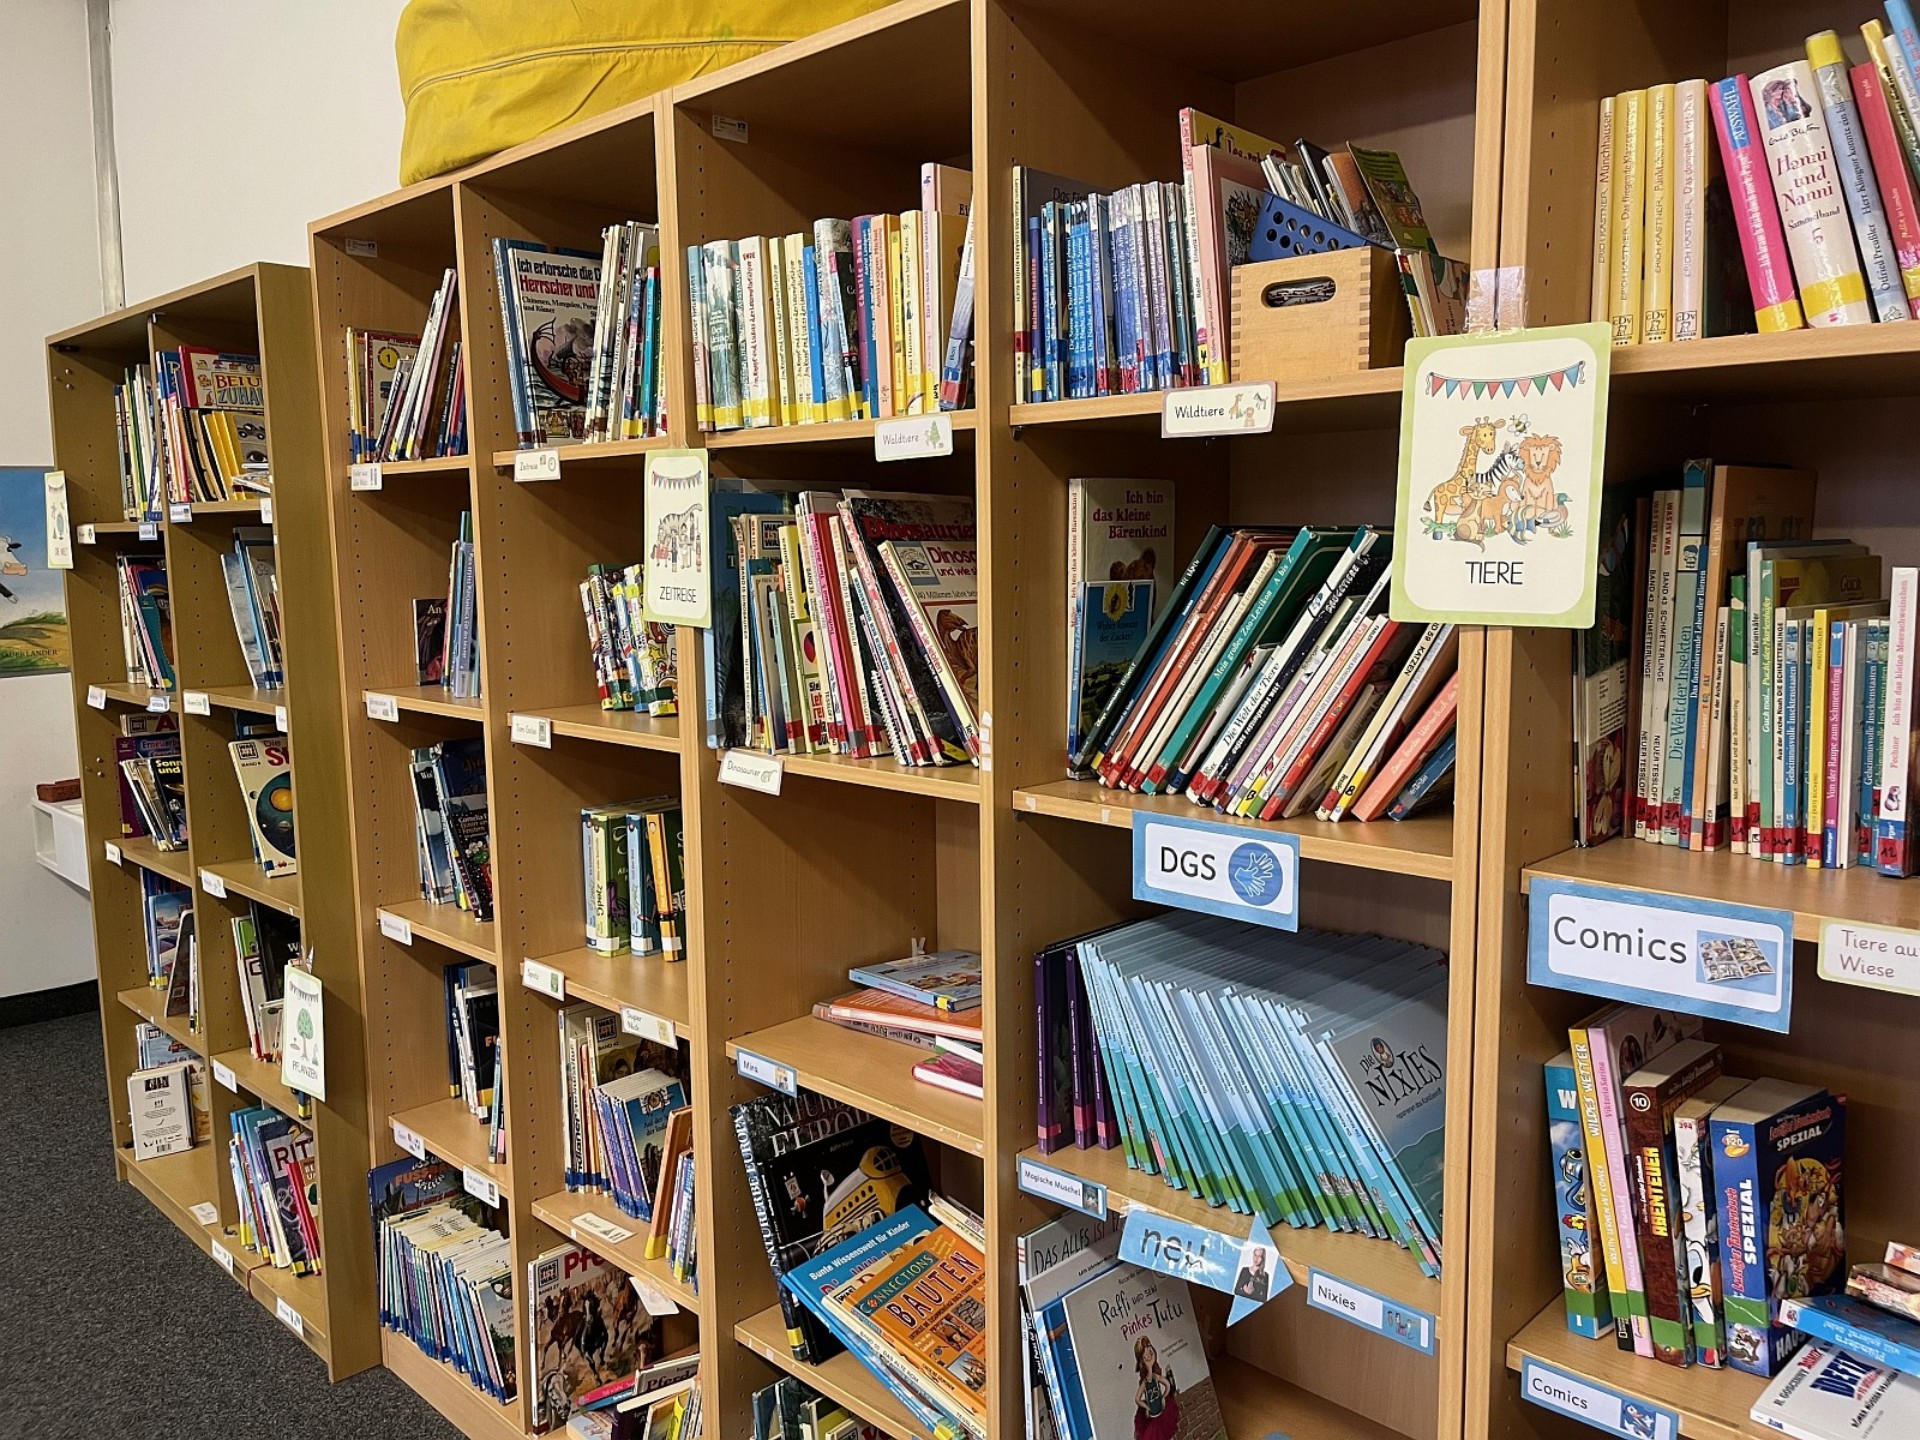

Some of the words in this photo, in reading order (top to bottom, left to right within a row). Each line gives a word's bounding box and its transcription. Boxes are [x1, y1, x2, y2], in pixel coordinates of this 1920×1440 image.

[1724, 85, 1746, 140] AUSWAHL
[1600, 111, 1612, 183] Münchhausen
[1776, 146, 1828, 177] Hanni
[1683, 177, 1693, 195] Das
[1794, 165, 1828, 188] und
[1781, 181, 1833, 212] Nanni
[1861, 194, 1872, 215] Herr
[1812, 227, 1823, 244] 5
[1867, 224, 1882, 259] Preußler
[517, 257, 532, 273] Ich
[534, 260, 578, 279] erforsche
[580, 264, 594, 279] die
[520, 275, 573, 297] Herrscher
[576, 283, 595, 299] und
[385, 353, 392, 364] 1
[216, 375, 246, 389] BEI
[1174, 404, 1225, 421] Wildtiere
[882, 432, 919, 446] Waldtiere
[1126, 491, 1143, 504] Ich
[1146, 491, 1164, 504] bin
[1093, 508, 1113, 522] das
[1116, 508, 1150, 522] kleine
[1665, 502, 1674, 521] WAS
[1108, 525, 1167, 539] Bärenkind
[1664, 522, 1673, 536] IST
[1663, 537, 1672, 556] WAS
[937, 568, 955, 576] und
[957, 568, 970, 576] wie
[1465, 560, 1525, 585] TIERE
[1648, 569, 1657, 592] BAND
[1662, 571, 1670, 595] BAND
[1696, 569, 1706, 596] Bienen
[659, 586, 697, 603] ZEITREISE
[1695, 597, 1704, 607] der
[427, 604, 442, 614] An
[845, 599, 857, 646] DINOSAURIER
[881, 547, 908, 597] Dinosaurier
[905, 600, 917, 616] und
[914, 615, 924, 634] wie
[921, 634, 930, 647] sie
[928, 646, 943, 674] lebten
[1213, 660, 1230, 680] Mein
[1227, 638, 1244, 661] großes
[1241, 590, 1273, 637] Zoo-Lexikon
[1273, 577, 1281, 586] A
[1278, 564, 1289, 577] bis
[1286, 554, 1295, 564] Z
[1693, 608, 1703, 634] Leben
[1896, 580, 1908, 656] Meerschweinchen
[1643, 607, 1655, 679] SCHMETTERLINGE
[1657, 609, 1668, 682] SCHMETTERLINGE
[1672, 624, 1692, 680] Insekten
[1775, 622, 1784, 682] SCHMETTERLINGE
[1403, 646, 1427, 677] KATZEN
[1690, 636, 1702, 683] faszinierende
[1893, 653, 1903, 678] kleine
[1671, 682, 1687, 704] der
[1689, 685, 1698, 698] Das
[1787, 665, 1796, 724] Insektenstaaten
[1829, 668, 1842, 721] Schmetterling
[1866, 665, 1877, 723] Insektenstaaten
[1892, 680, 1901, 695] das
[1223, 728, 1237, 747] Die
[1235, 709, 1250, 731] Welt
[1250, 688, 1262, 707] der
[1260, 662, 1280, 688] Tiere
[1892, 697, 1901, 710] bin
[1669, 706, 1686, 735] Welt
[1830, 723, 1838, 740] zum
[1891, 712, 1900, 725] Ich
[264, 739, 281, 747] Die
[1667, 737, 1683, 761] Die
[1786, 726, 1795, 785] Geheimnisvolle
[1828, 742, 1839, 770] Raupe
[1863, 726, 1875, 785] Geheimnisvolle
[1889, 736, 1899, 768] Fechner
[157, 766, 182, 774] und
[727, 760, 760, 777] Dinosaurier
[1639, 758, 1647, 797] TESSLOFF
[1827, 772, 1837, 784] der
[1651, 763, 1659, 802] TESSLOFF
[1827, 786, 1836, 798] Von
[1161, 846, 1217, 881] DGS
[1554, 916, 1687, 964] Comics
[1841, 928, 1887, 953] Tiere
[1894, 942, 1919, 958] au
[1839, 953, 1895, 979] Wiese
[626, 1010, 642, 1023] Super
[292, 1060, 318, 1081] PFLANZEN
[1359, 1055, 1376, 1075] Die
[1365, 1042, 1442, 1107] NIXIES
[1575, 1043, 1595, 1093] WETTER
[1632, 1097, 1647, 1107] 10
[1582, 1096, 1600, 1137] WILDES
[734, 1112, 757, 1175] EUROPA
[1725, 1137, 1742, 1147] 120
[1776, 1125, 1823, 1152] SPEZIAL
[1024, 1170, 1053, 1187] Magische
[1053, 1180, 1082, 1198] Muschel
[1643, 1147, 1669, 1237] ABENTEUER
[750, 1176, 780, 1268] NATURERBE
[1725, 1187, 1742, 1249] Taschenbuch
[1740, 1179, 1758, 1265] SPEZIAL
[809, 1264, 833, 1281] Bunte
[832, 1240, 877, 1271] Wissenswelt
[877, 1233, 887, 1244] für
[887, 1221, 911, 1239] Kinder
[1141, 1225, 1206, 1267] neu
[540, 1261, 557, 1273] WAS
[541, 1269, 555, 1277] IST
[1034, 1244, 1058, 1276] DAS
[540, 1275, 558, 1285] WAS
[859, 1255, 934, 1314] CONNECTIONS
[885, 1251, 981, 1329] BAUTEN
[1098, 1290, 1131, 1327] Raffi
[1318, 1285, 1356, 1311] Nixies
[1121, 1313, 1153, 1341] pinkes
[1147, 1299, 1185, 1329] Tutu
[859, 1330, 873, 1344] BAND
[882, 1351, 893, 1362] DAS
[892, 1359, 907, 1373] ALTE
[905, 1370, 920, 1384] ROM
[1532, 1377, 1588, 1410] Comics
[1781, 1368, 1810, 1403] GOSCINNY
